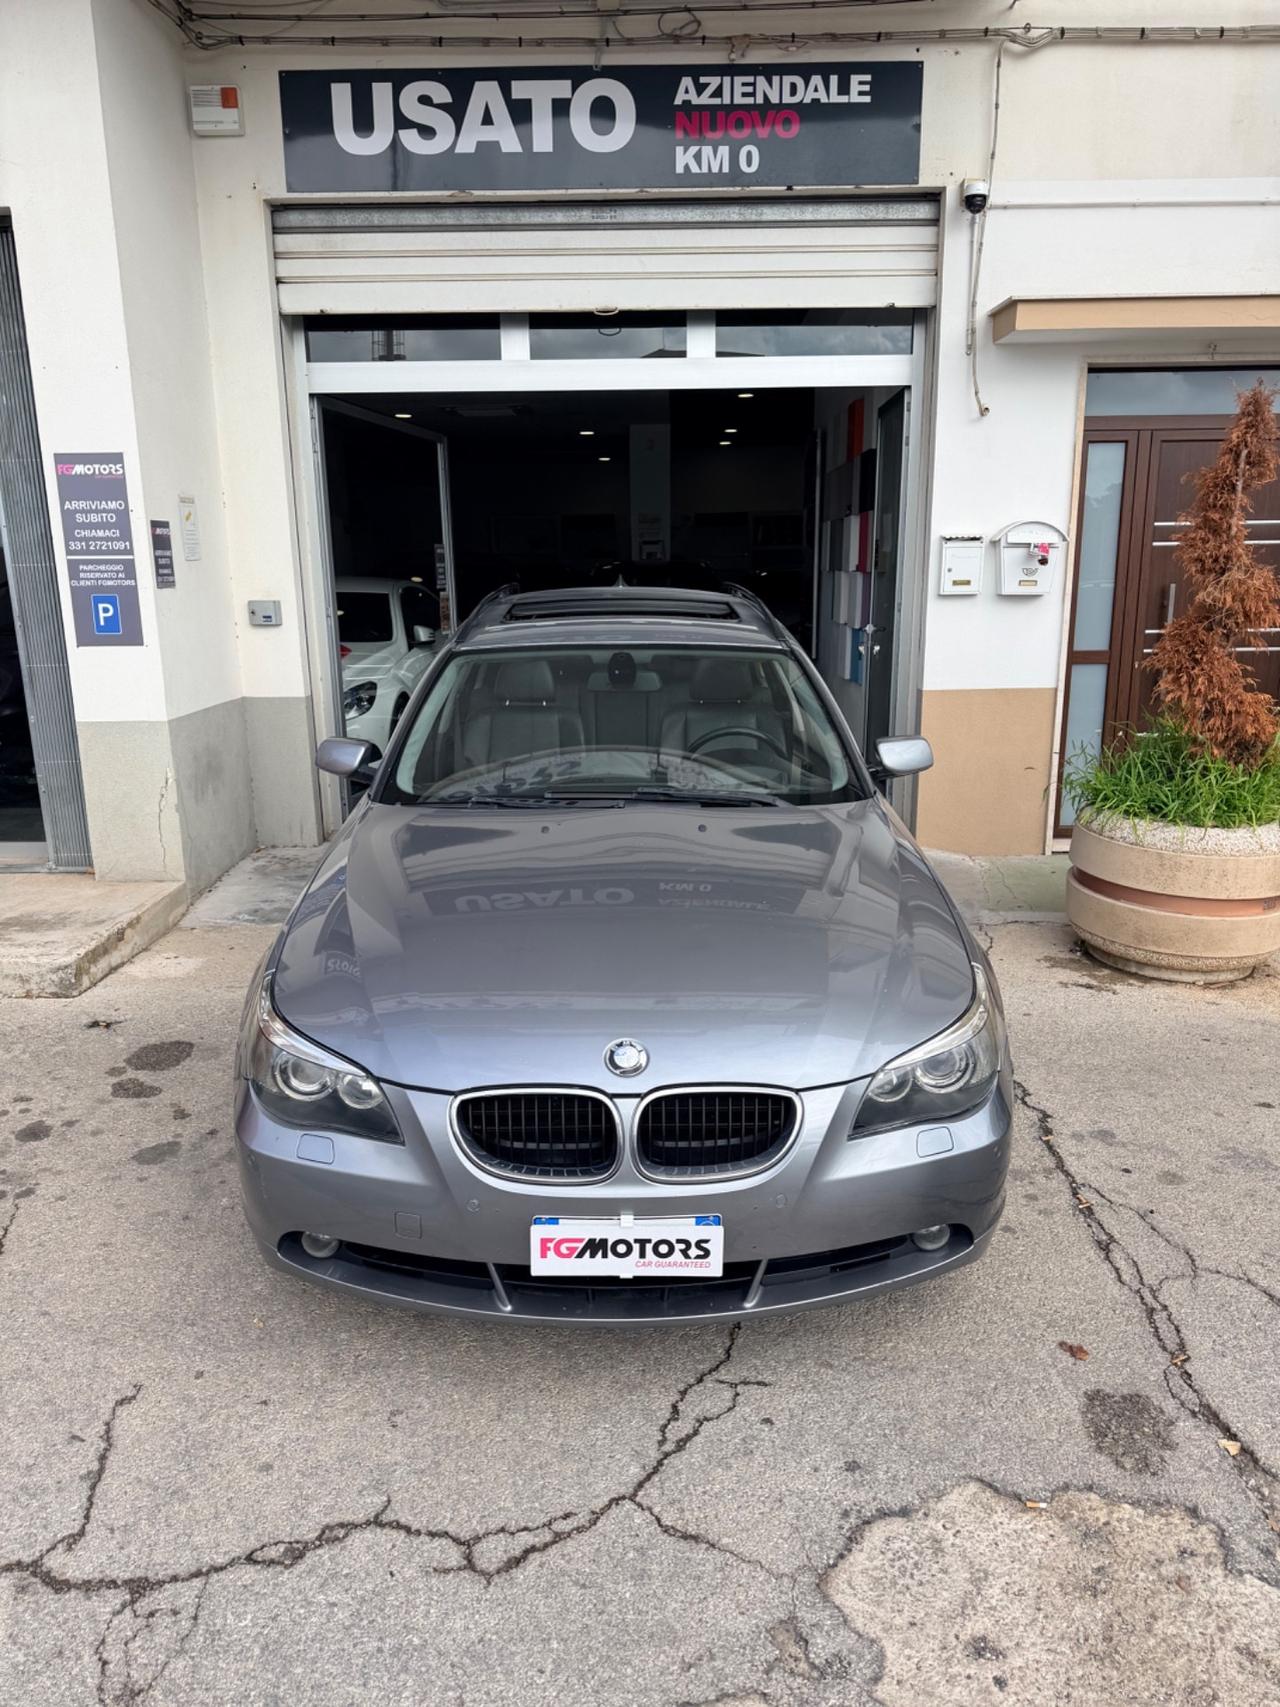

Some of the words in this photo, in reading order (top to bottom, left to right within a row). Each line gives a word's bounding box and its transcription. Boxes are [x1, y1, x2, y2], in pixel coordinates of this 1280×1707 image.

[674, 74, 871, 105] AZIENDALE
[331, 78, 636, 156] USATO
[675, 110, 801, 141] NUOVO
[675, 145, 730, 175] KM
[739, 145, 760, 174] 0
[57, 464, 124, 475] FGMOTORS
[64, 500, 125, 511] ARRIVIAMO
[75, 513, 116, 523] SUBITO
[74, 529, 120, 538] CHIAMACI
[68, 541, 86, 550] 331
[89, 540, 130, 550] 2721091
[71, 579, 97, 587] CLIENTI
[98, 579, 136, 587] FGMOTORS
[97, 603, 114, 626] P
[540, 1238, 712, 1260] FGMOTORS
[635, 1260, 653, 1268] CAR
[655, 1260, 711, 1269] GUARANTEED
